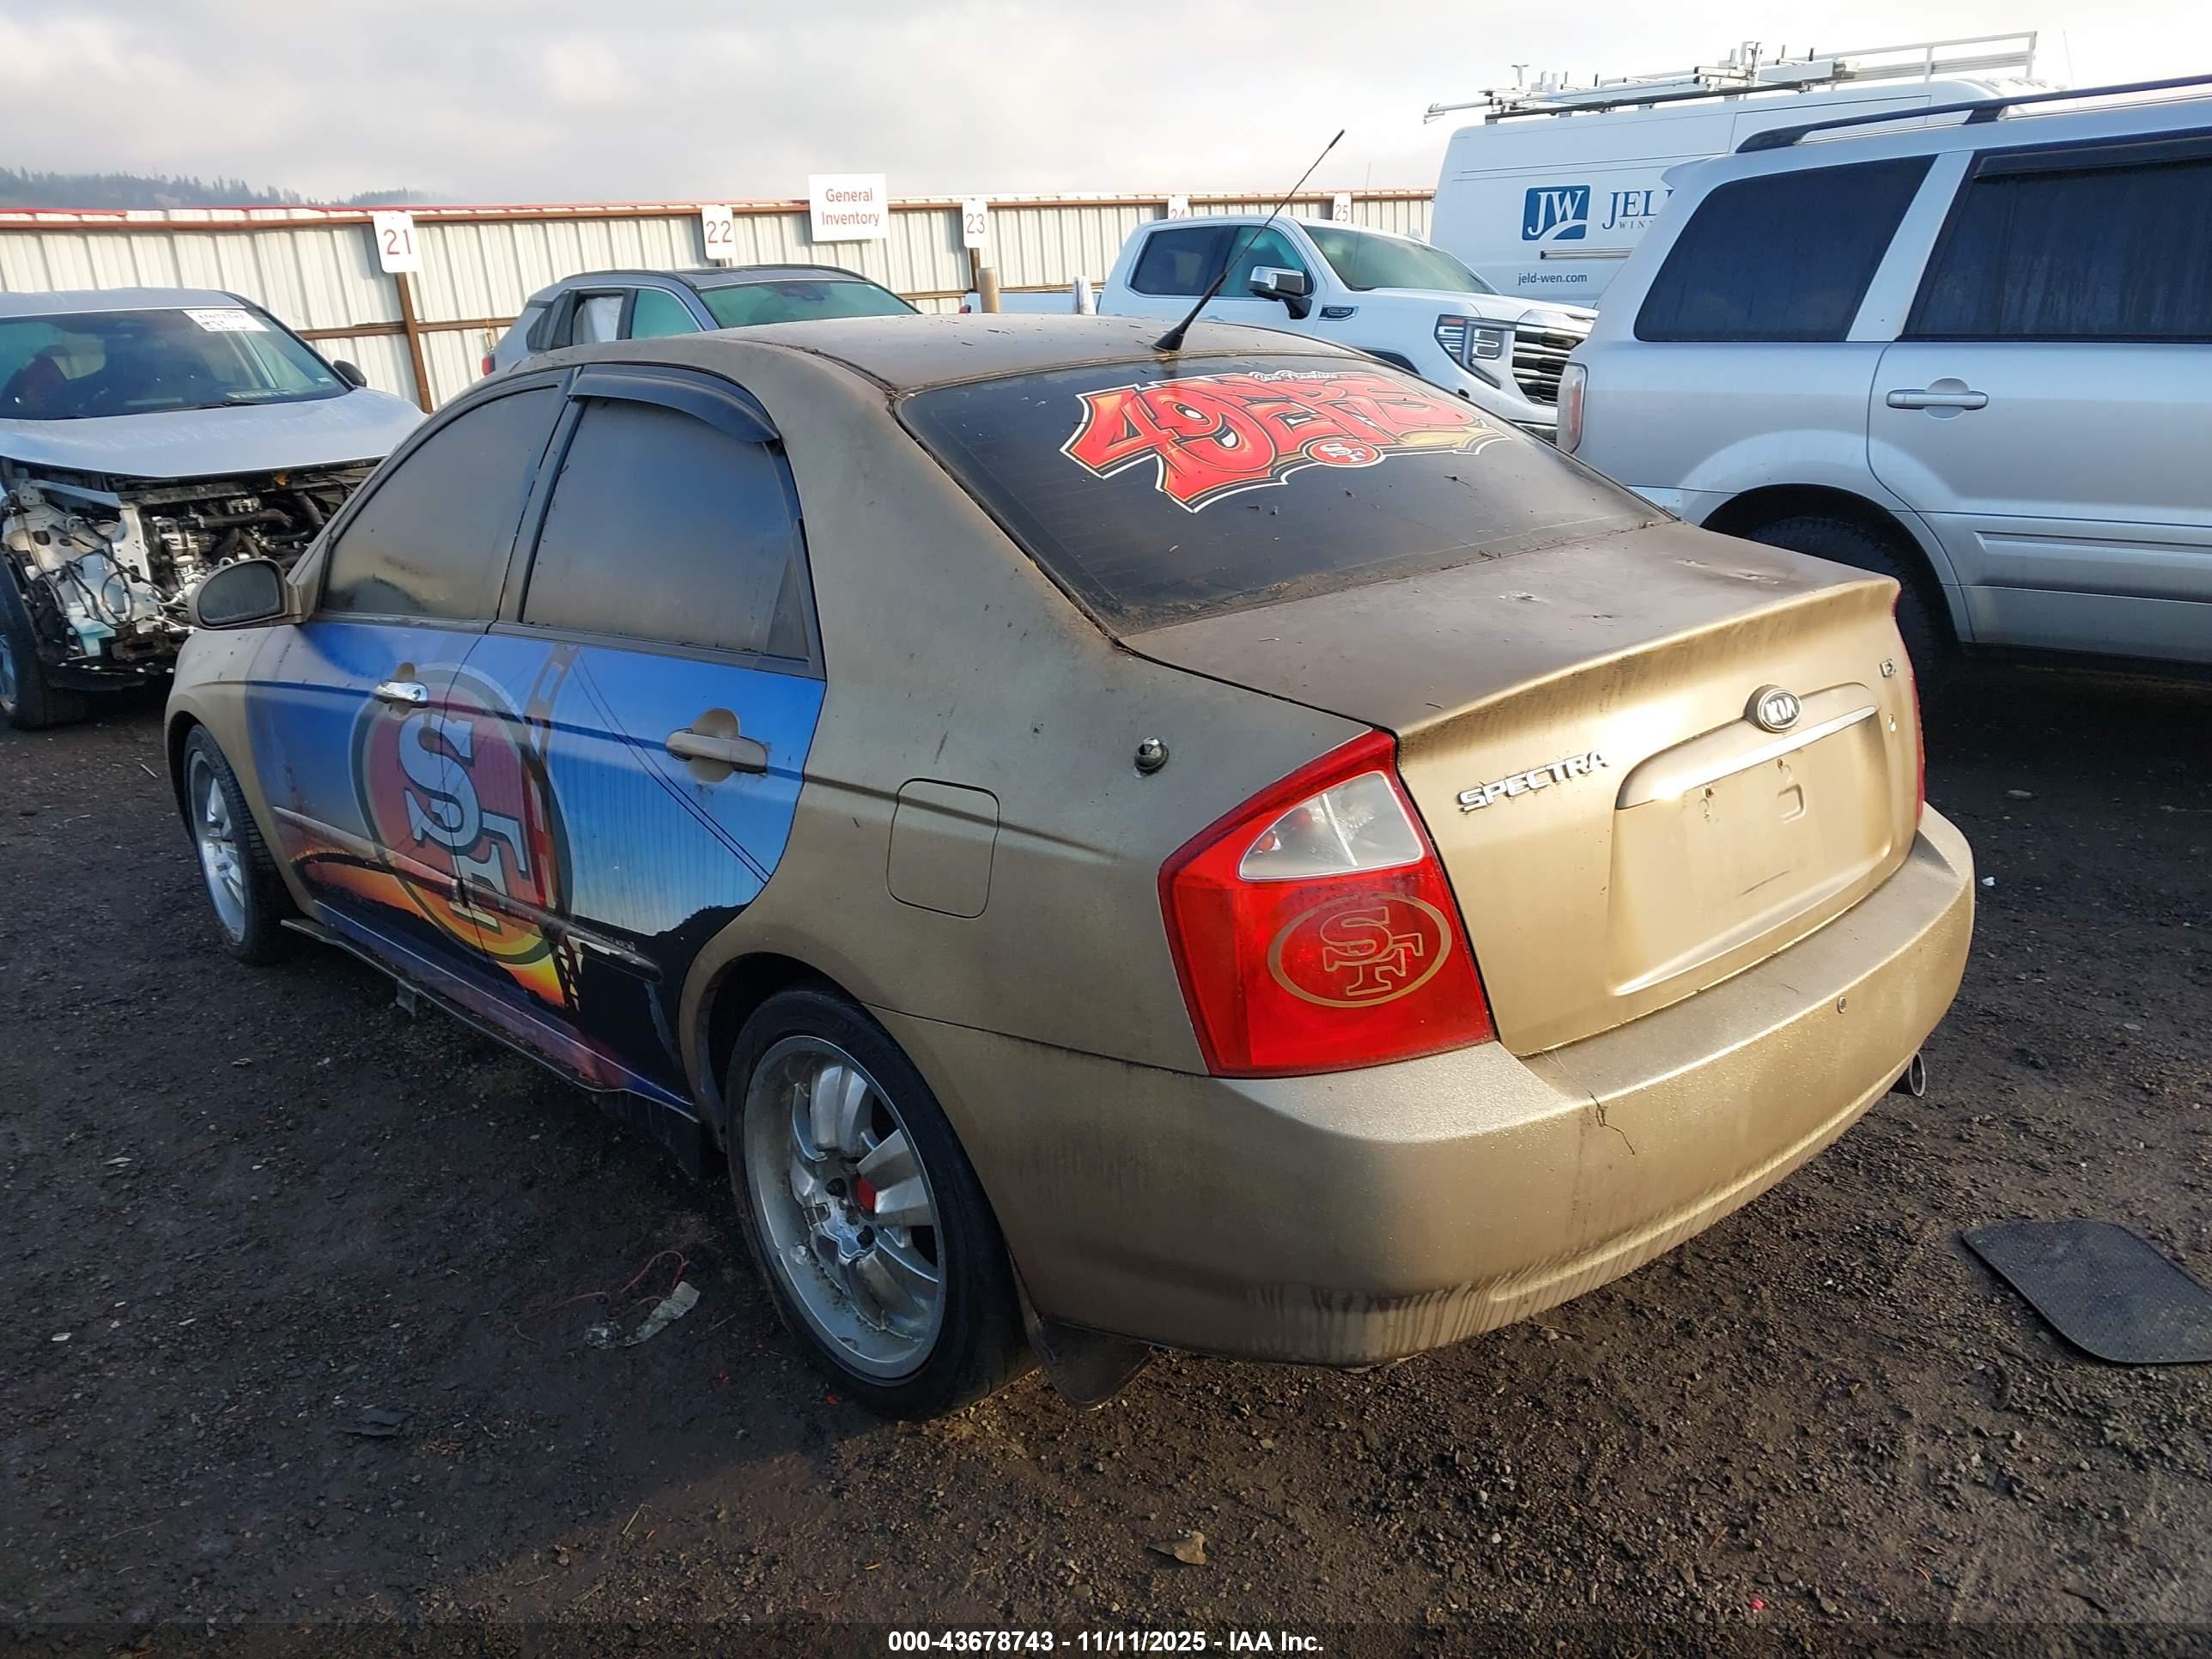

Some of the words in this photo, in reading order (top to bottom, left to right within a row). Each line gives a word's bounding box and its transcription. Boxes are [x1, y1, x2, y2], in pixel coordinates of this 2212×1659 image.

[825, 188, 873, 203] General
[822, 211, 880, 228] Inventory
[1335, 204, 1349, 222] 25
[1527, 190, 1585, 236] JW
[1601, 189, 1674, 230] JEL
[706, 220, 732, 245] 22
[966, 213, 986, 234] 23
[1619, 220, 1654, 230] WIN
[383, 228, 411, 255] 21
[1518, 272, 1588, 286] jeld-wen.com
[1765, 696, 1799, 724] KIA
[1458, 750, 1611, 813] SPECTRA
